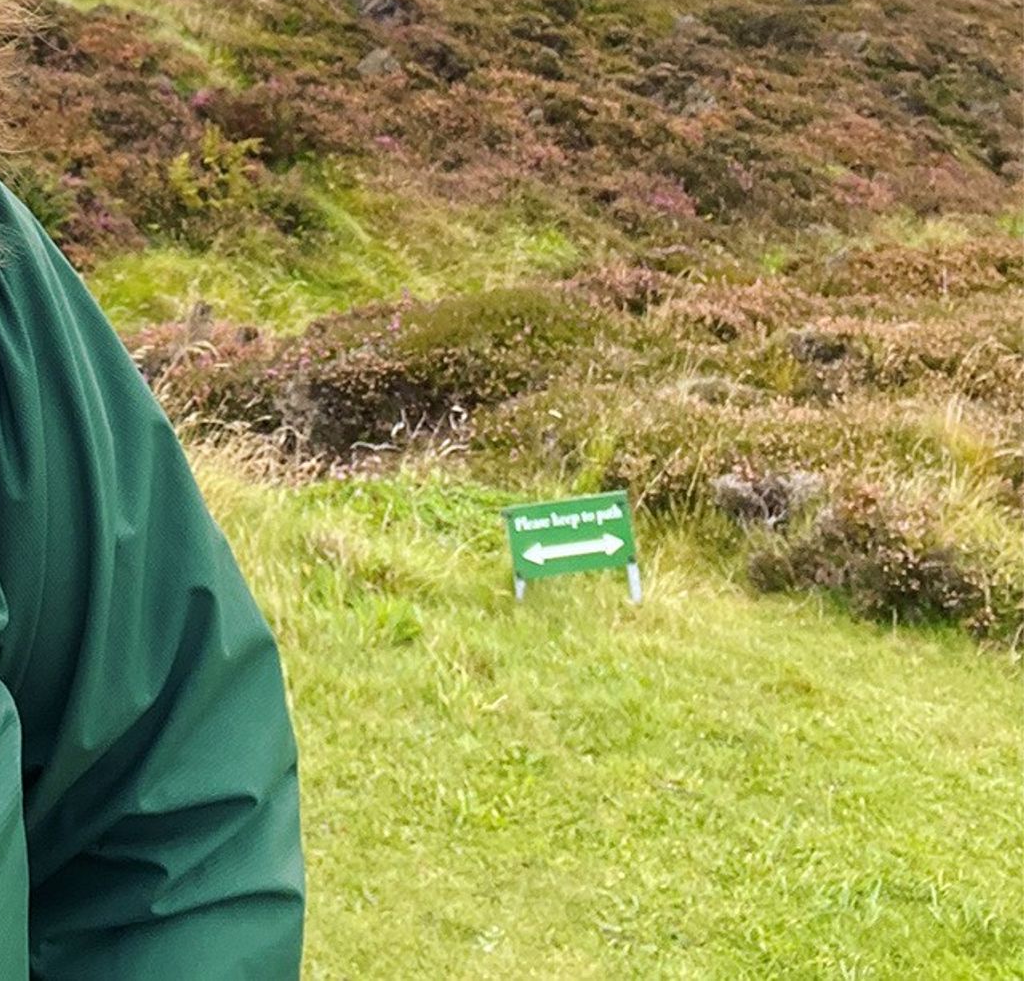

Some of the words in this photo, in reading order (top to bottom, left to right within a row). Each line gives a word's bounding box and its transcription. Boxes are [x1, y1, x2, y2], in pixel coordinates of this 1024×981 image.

[513, 516, 551, 532] Please
[550, 511, 580, 529] keep
[580, 511, 596, 523] to
[596, 503, 624, 526] path
